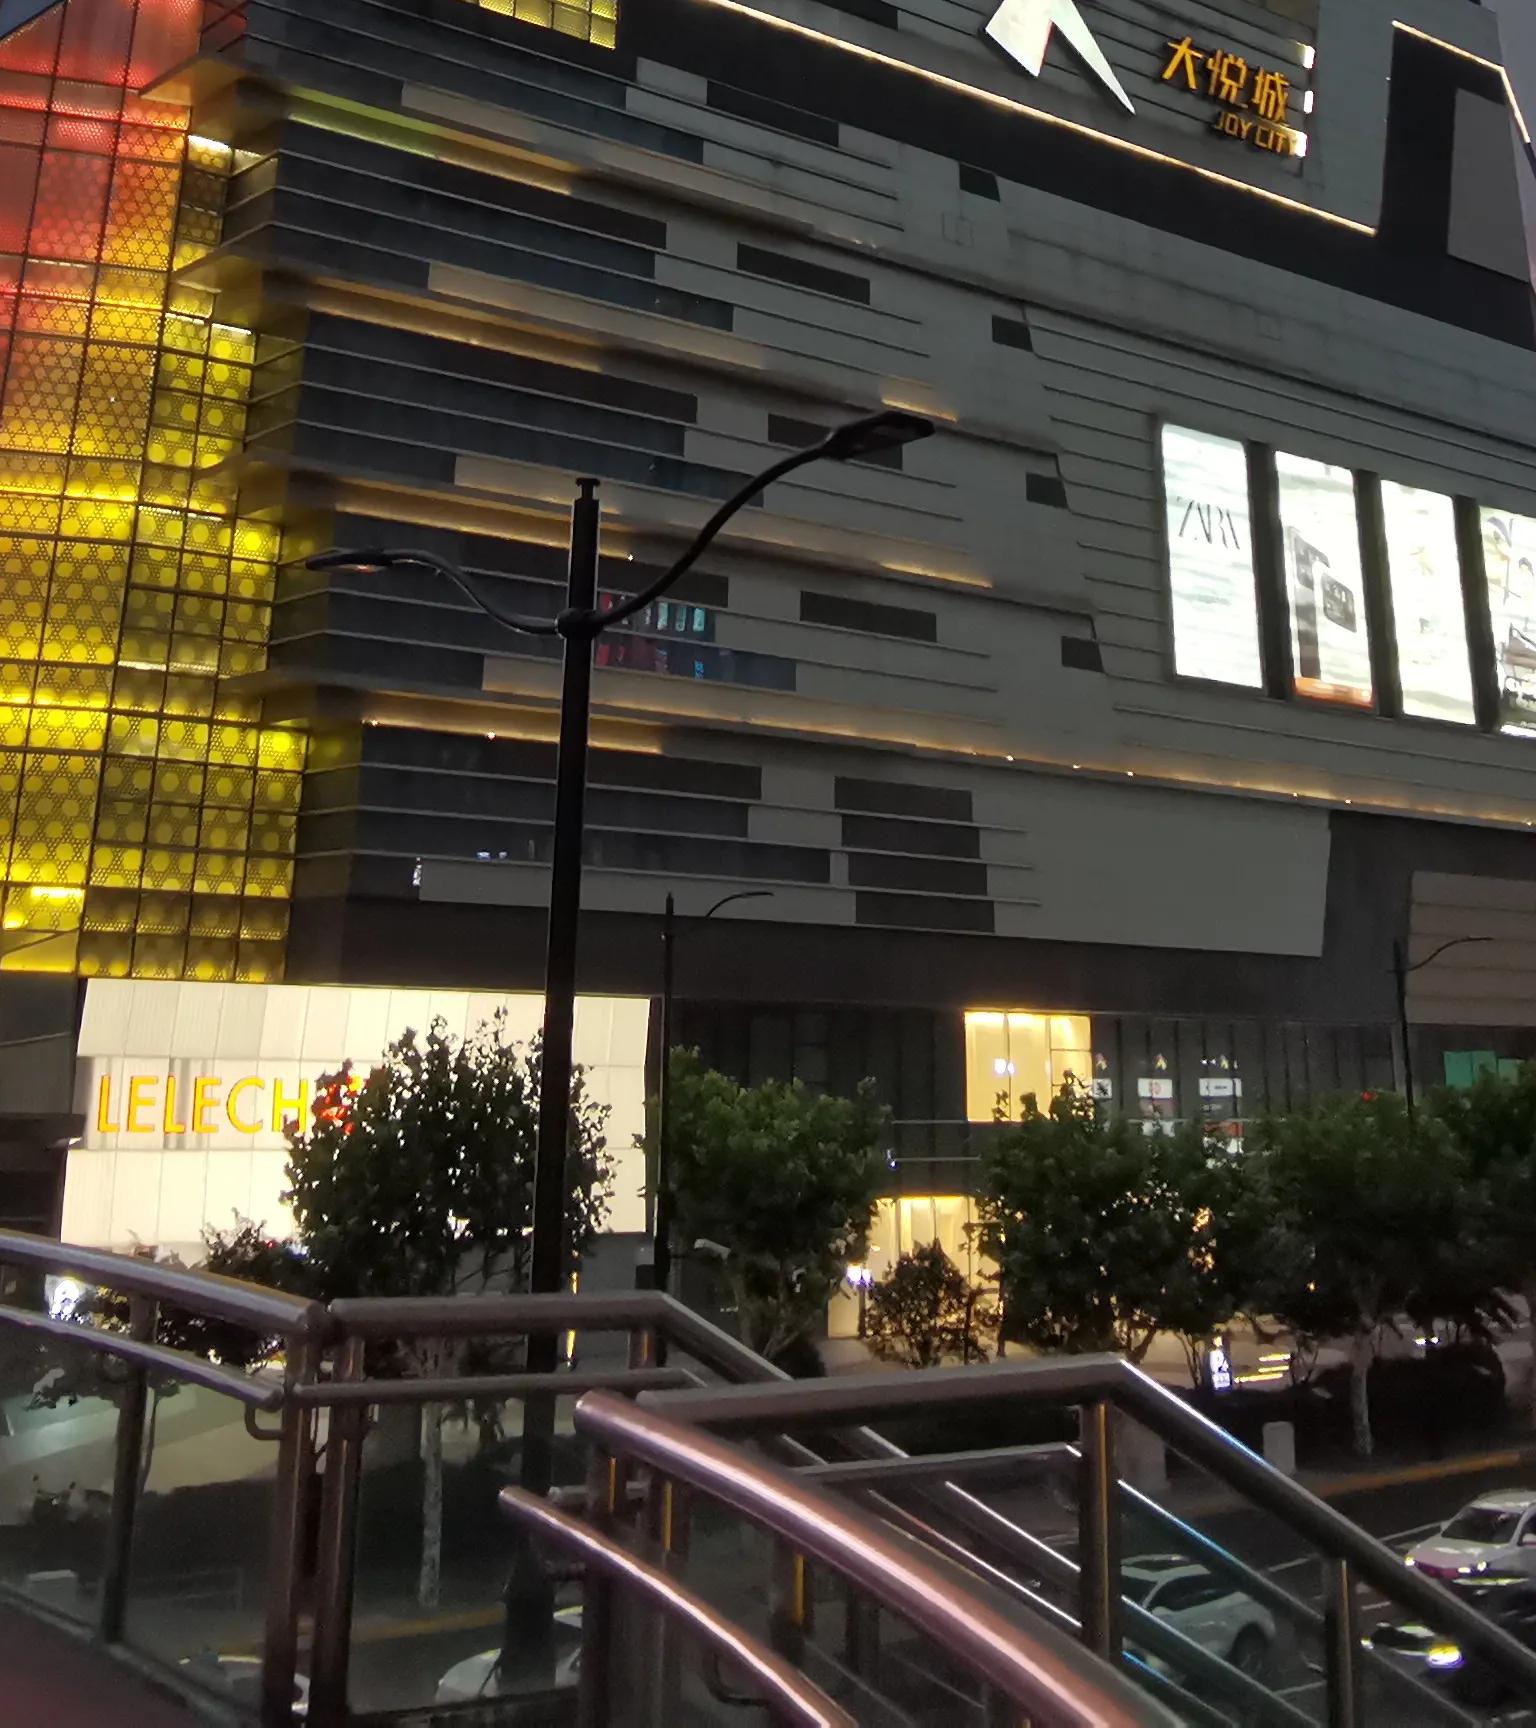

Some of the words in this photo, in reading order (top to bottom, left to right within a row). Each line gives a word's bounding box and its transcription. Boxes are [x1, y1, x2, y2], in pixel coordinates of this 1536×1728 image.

[1162, 35, 1290, 121] 大悦城
[1212, 111, 1253, 140] JOY
[1254, 125, 1300, 156] CITY
